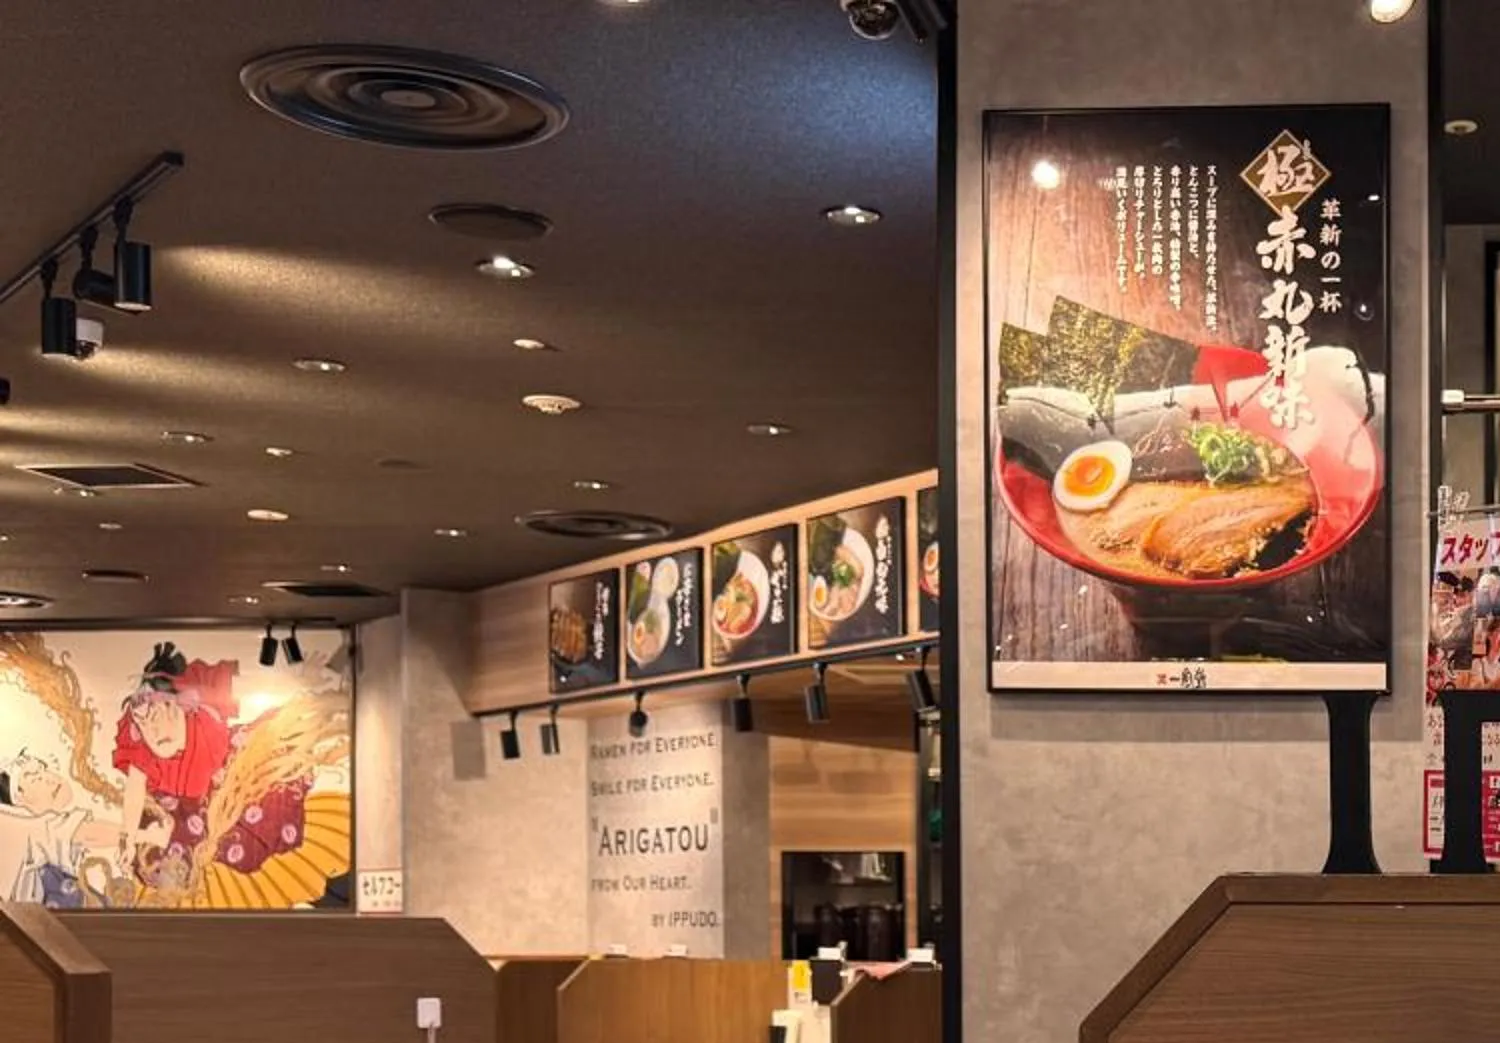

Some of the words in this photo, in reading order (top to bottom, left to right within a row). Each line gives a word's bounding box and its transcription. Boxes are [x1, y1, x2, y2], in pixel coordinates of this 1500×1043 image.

[1319, 200, 1342, 314] 革新の一杯
